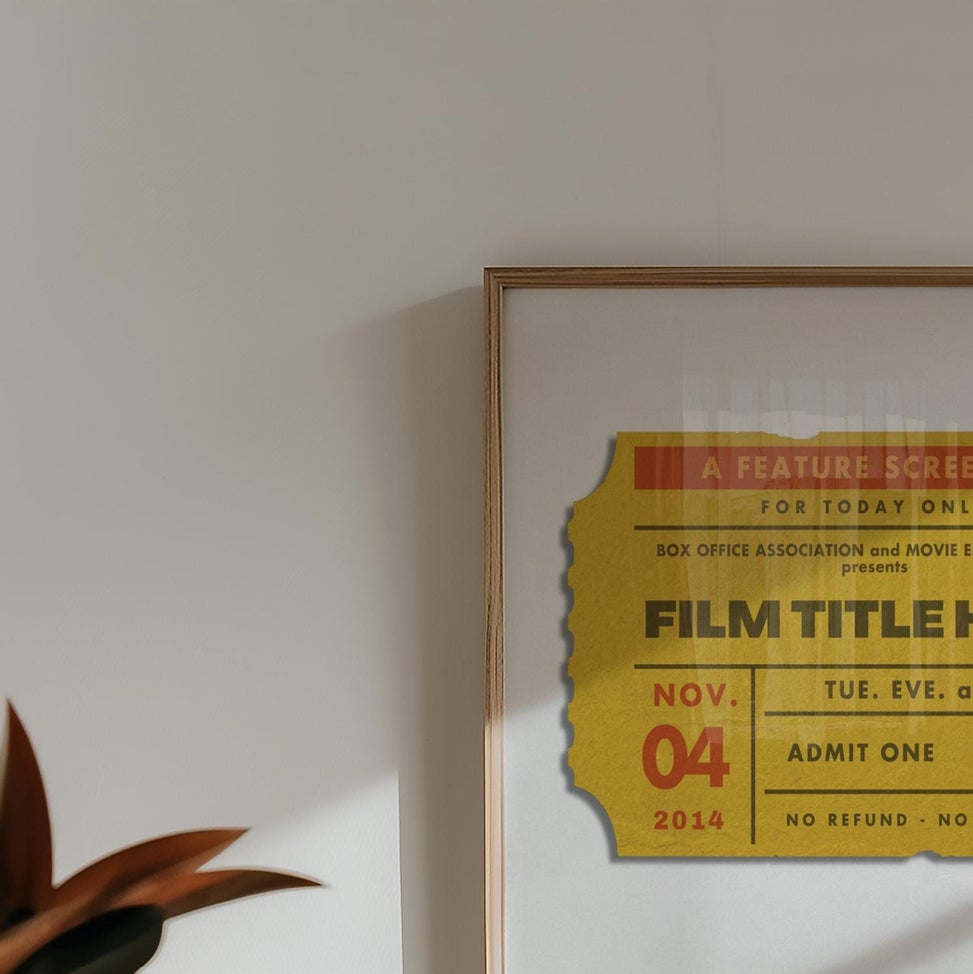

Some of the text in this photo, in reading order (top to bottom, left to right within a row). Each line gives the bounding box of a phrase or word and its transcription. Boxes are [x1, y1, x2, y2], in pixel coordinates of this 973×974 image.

[702, 456, 722, 479] A
[738, 456, 869, 479] FEATURE
[761, 500, 807, 514] FOR
[824, 500, 905, 514] TODAY
[656, 543, 691, 558] BOX
[697, 543, 750, 558] OFFICE
[755, 543, 865, 558] ASSOCIATION
[870, 542, 901, 558] and
[905, 543, 958, 558] MOVIE
[841, 560, 908, 576] presents
[644, 599, 781, 639] FILM
[791, 599, 945, 639] TITLE
[653, 682, 738, 708] NOV.
[825, 680, 879, 700] TUE.
[891, 680, 946, 700] EVE.
[641, 723, 731, 790] 04
[787, 742, 935, 763] ADMIT ONE
[653, 810, 724, 830] 2014
[786, 813, 816, 827] NO
[827, 813, 908, 827] REFUND
[938, 813, 969, 827] NO
